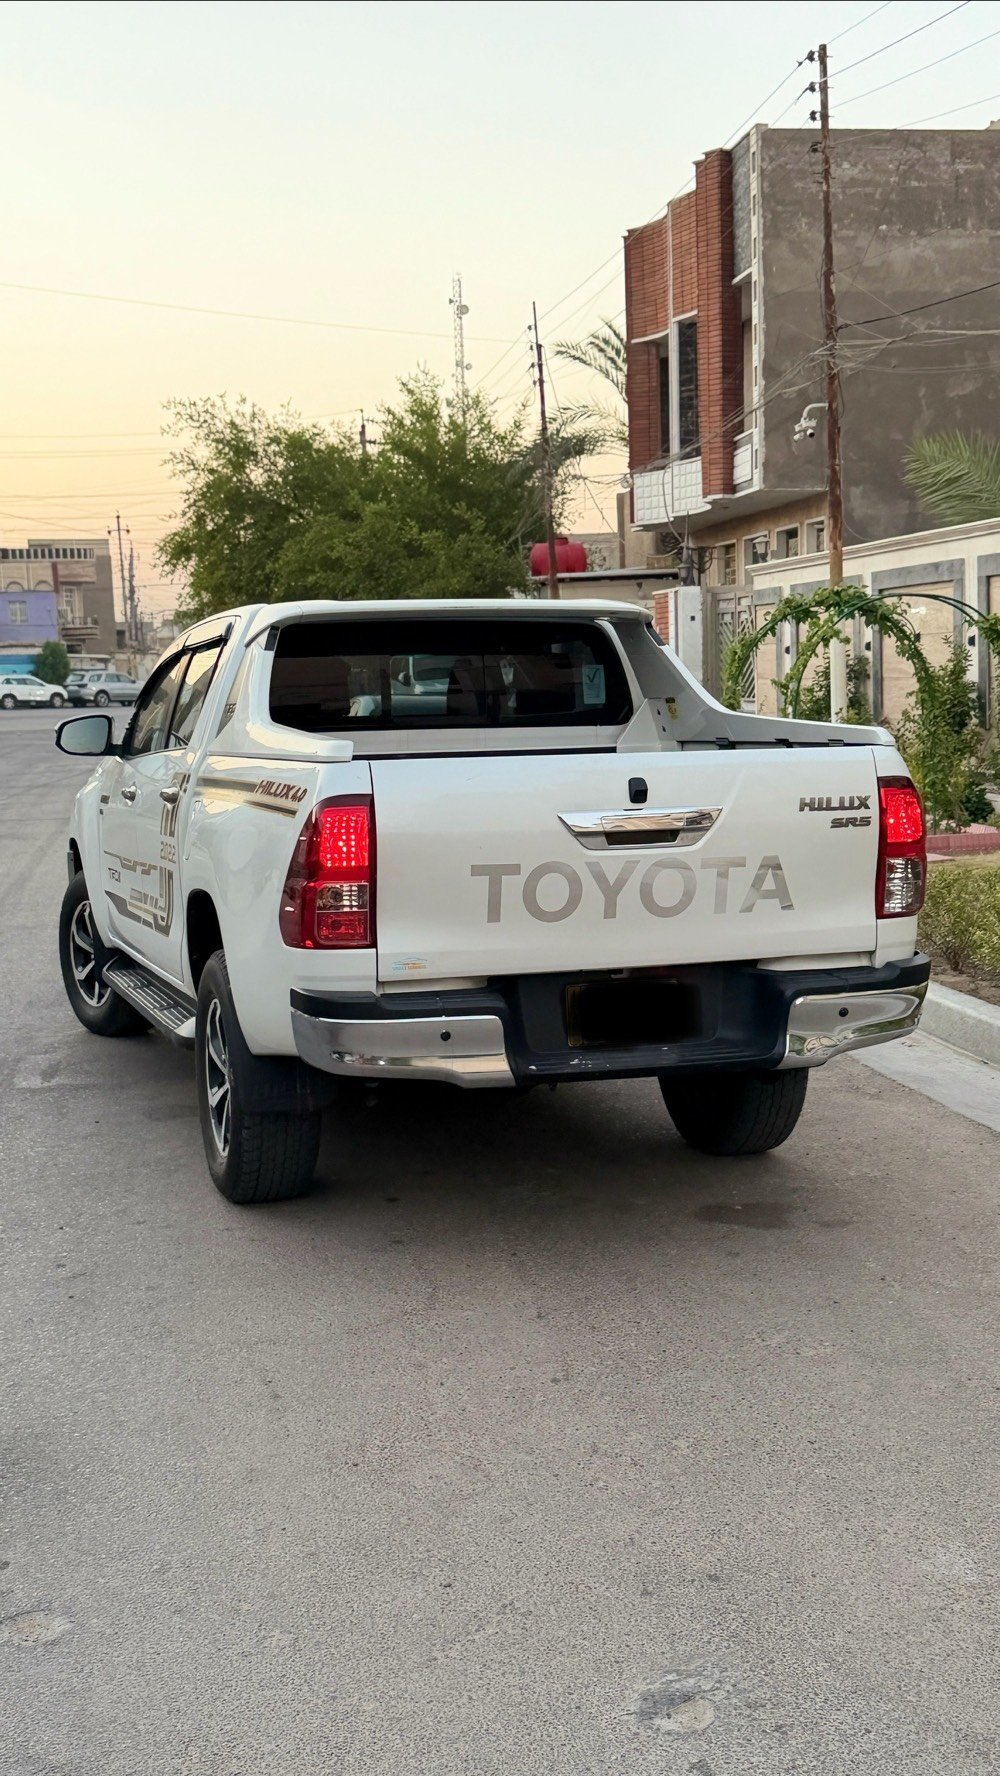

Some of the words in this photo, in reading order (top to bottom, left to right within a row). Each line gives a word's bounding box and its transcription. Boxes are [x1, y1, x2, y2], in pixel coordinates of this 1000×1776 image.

[256, 780, 296, 800] HILUX
[799, 795, 871, 812] HILUX
[830, 816, 872, 829] SR5
[471, 855, 795, 923] TOYOTA
